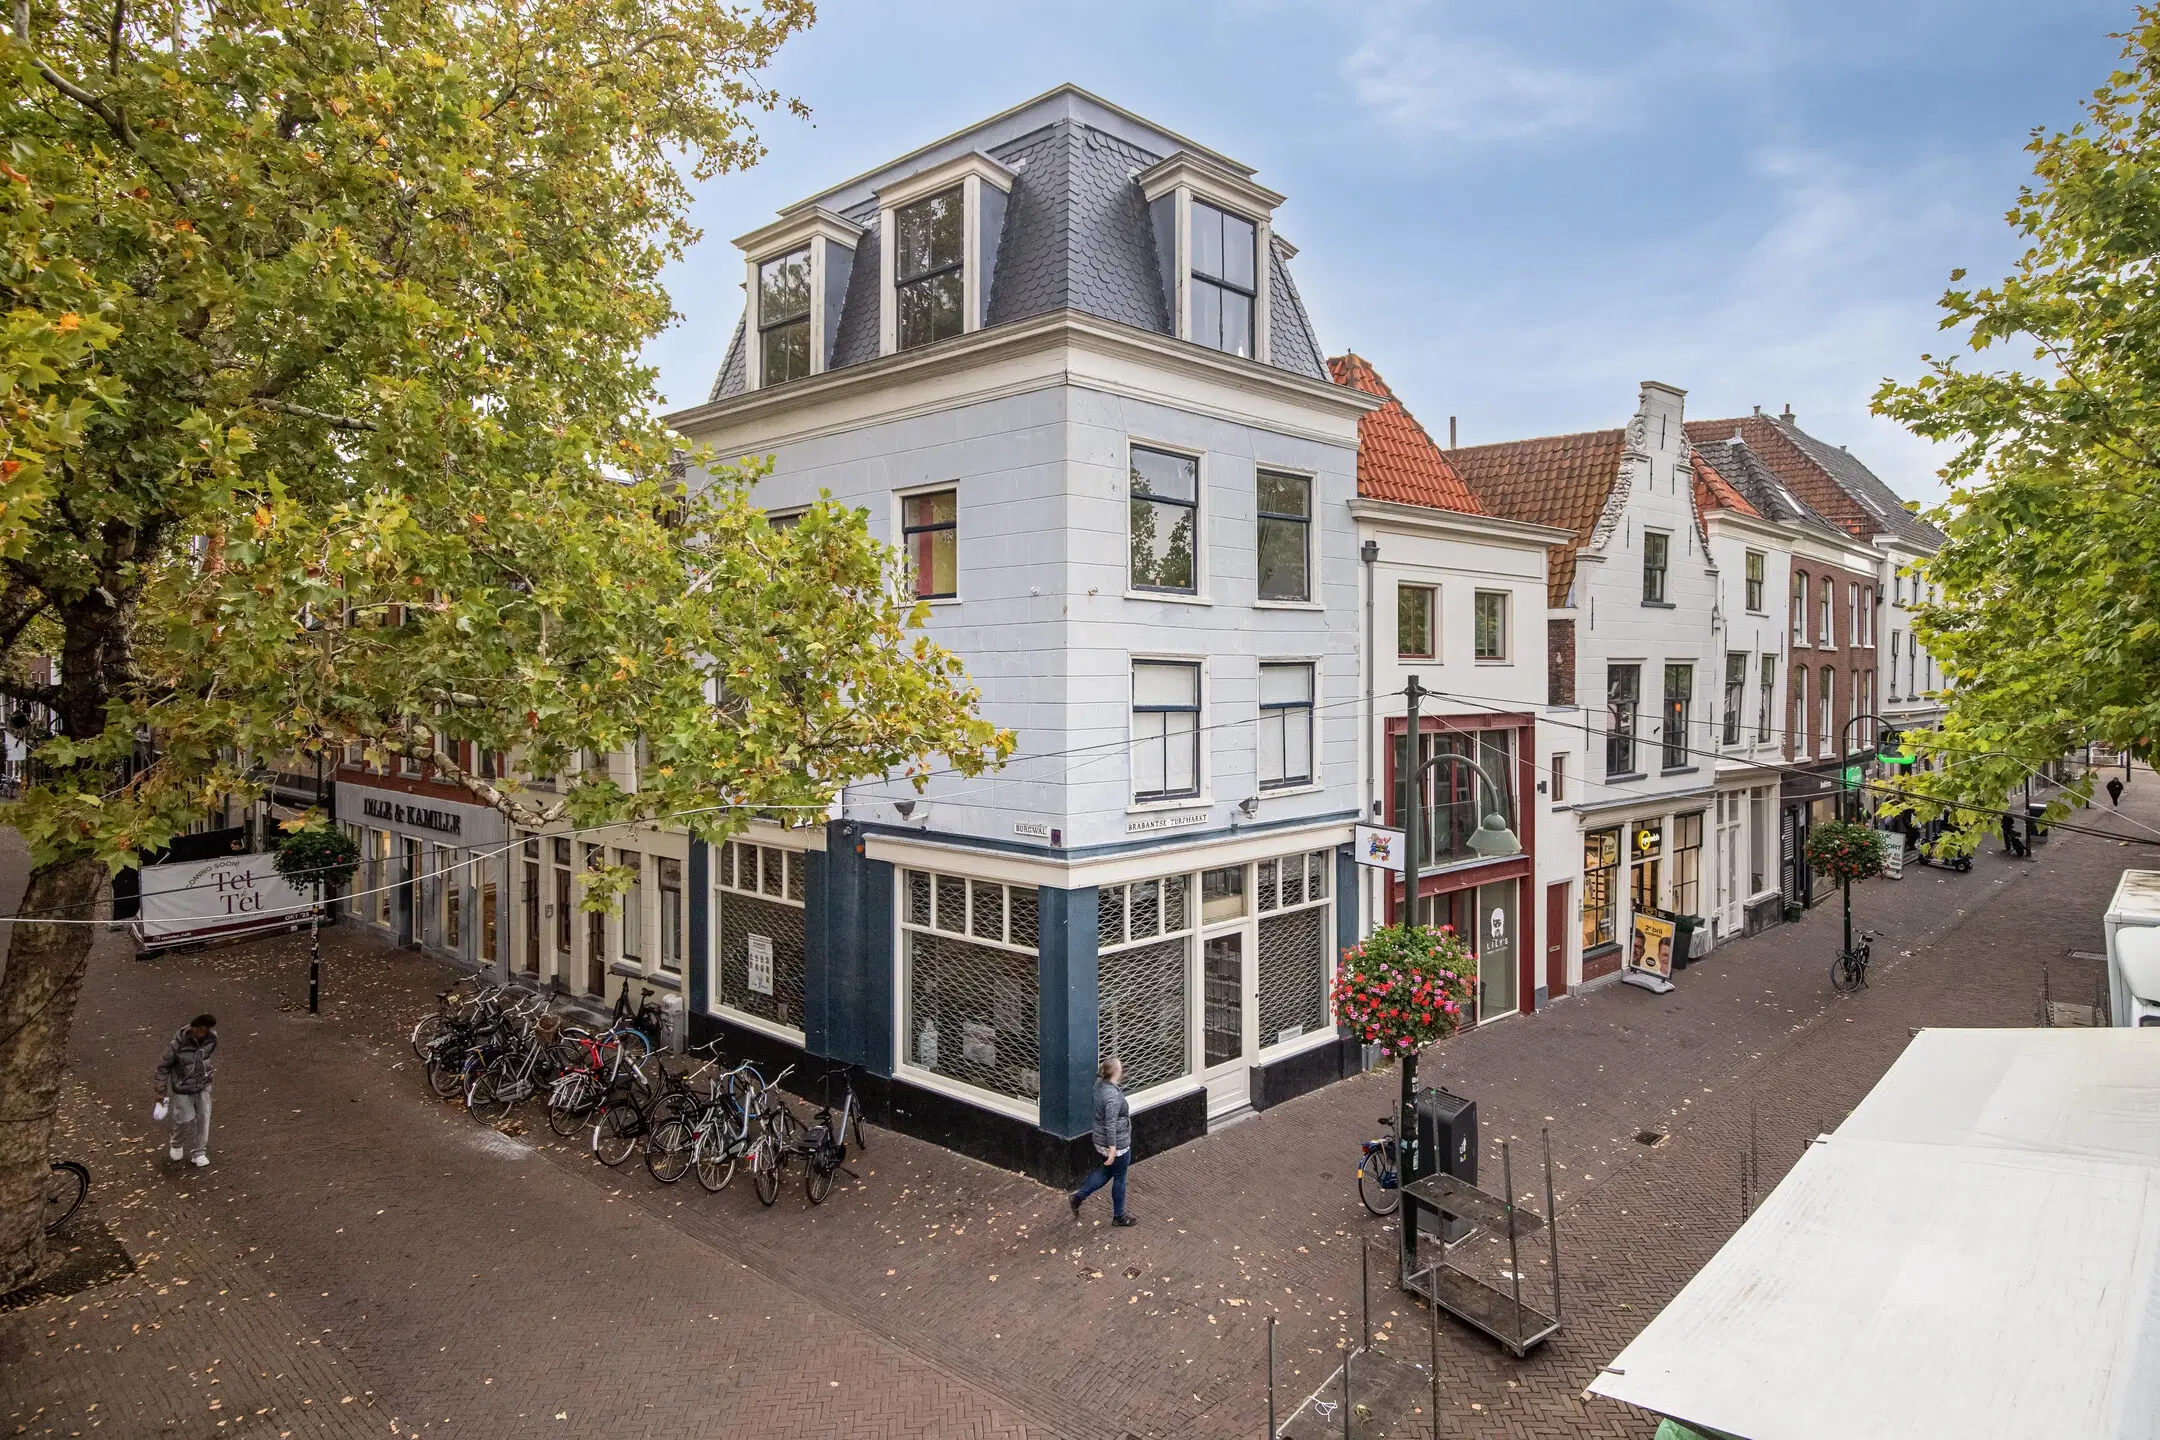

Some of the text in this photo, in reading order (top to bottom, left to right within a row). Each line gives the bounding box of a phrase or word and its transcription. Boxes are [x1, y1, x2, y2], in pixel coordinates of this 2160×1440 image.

[364, 797, 461, 836] DILLE & KAMILLE
[1128, 814, 1207, 831] BRABANTSE TURFMARKT
[1015, 824, 1047, 835] BURGWAL
[213, 861, 240, 869] SOON!
[211, 869, 256, 893] Tet
[220, 891, 265, 915] Tet
[284, 913, 298, 921] OKT
